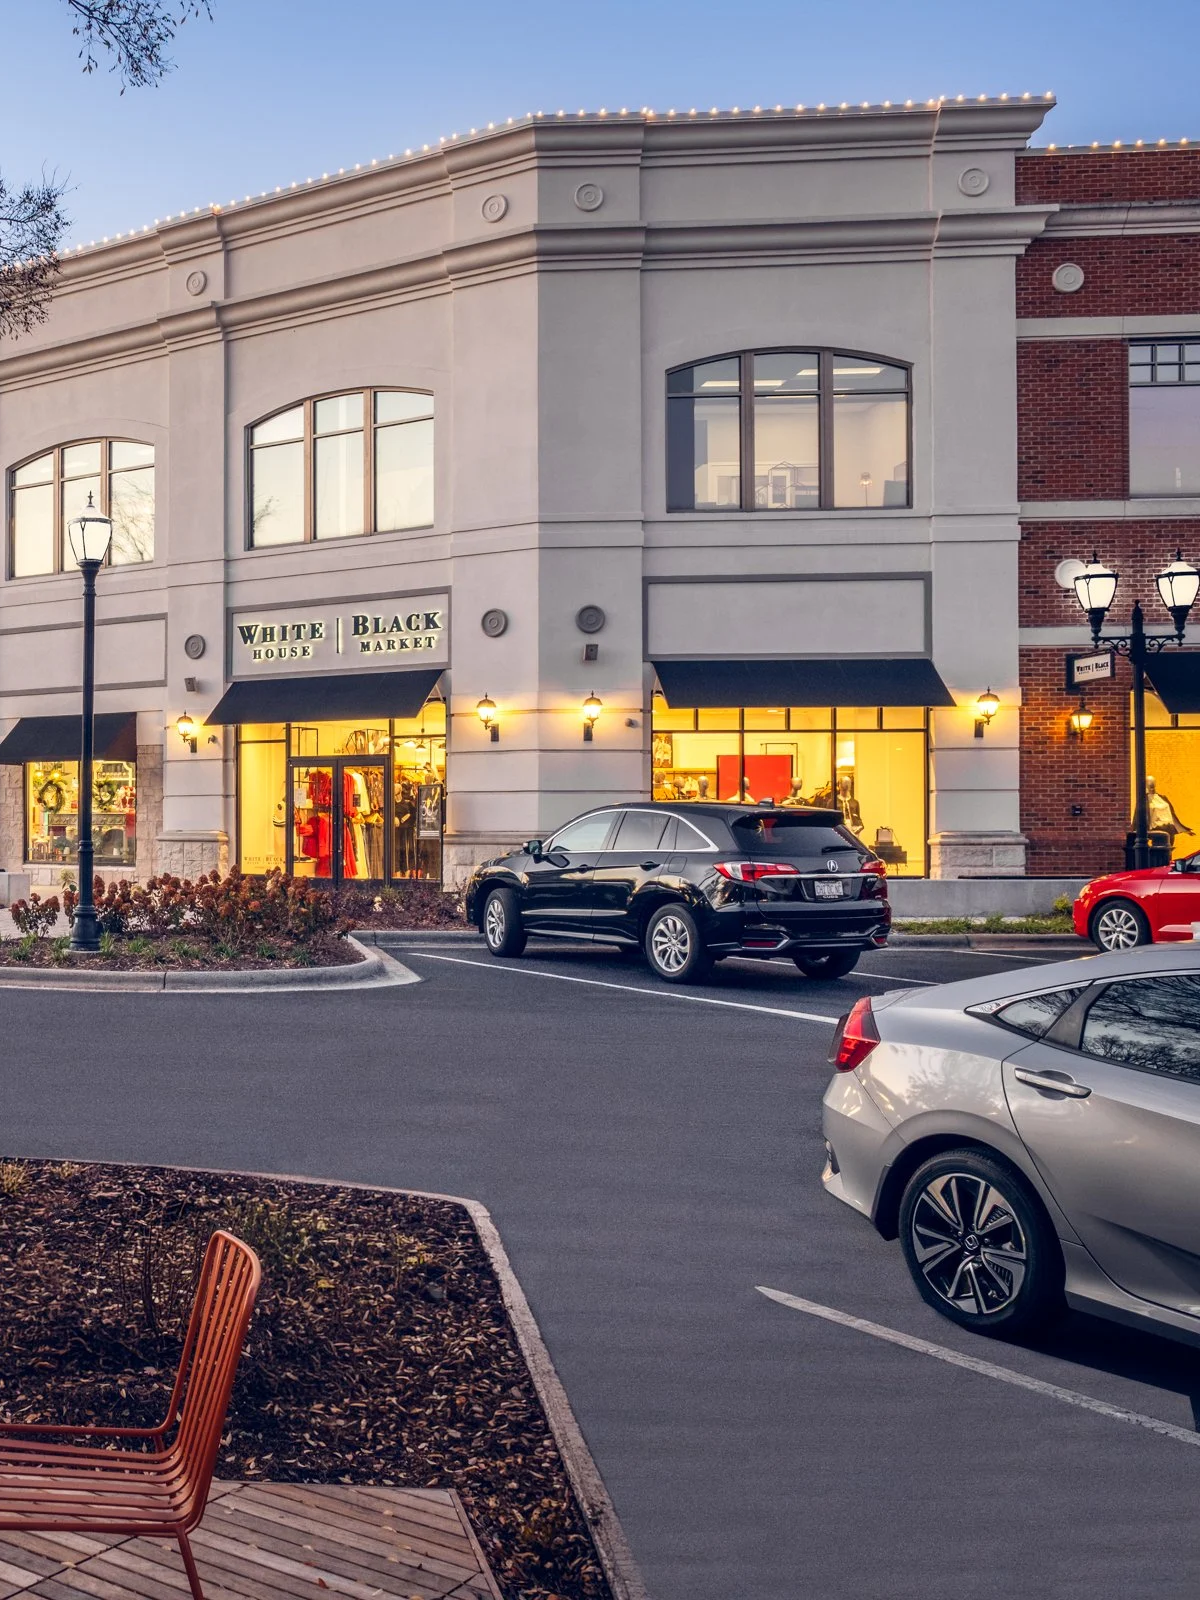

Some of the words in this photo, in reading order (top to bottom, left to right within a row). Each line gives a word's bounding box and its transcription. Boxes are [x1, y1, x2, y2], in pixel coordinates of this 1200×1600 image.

[237, 622, 323, 645] WHITE
[352, 611, 441, 636] BLACK
[253, 646, 310, 660] HOUSE
[360, 636, 435, 653] MARKET
